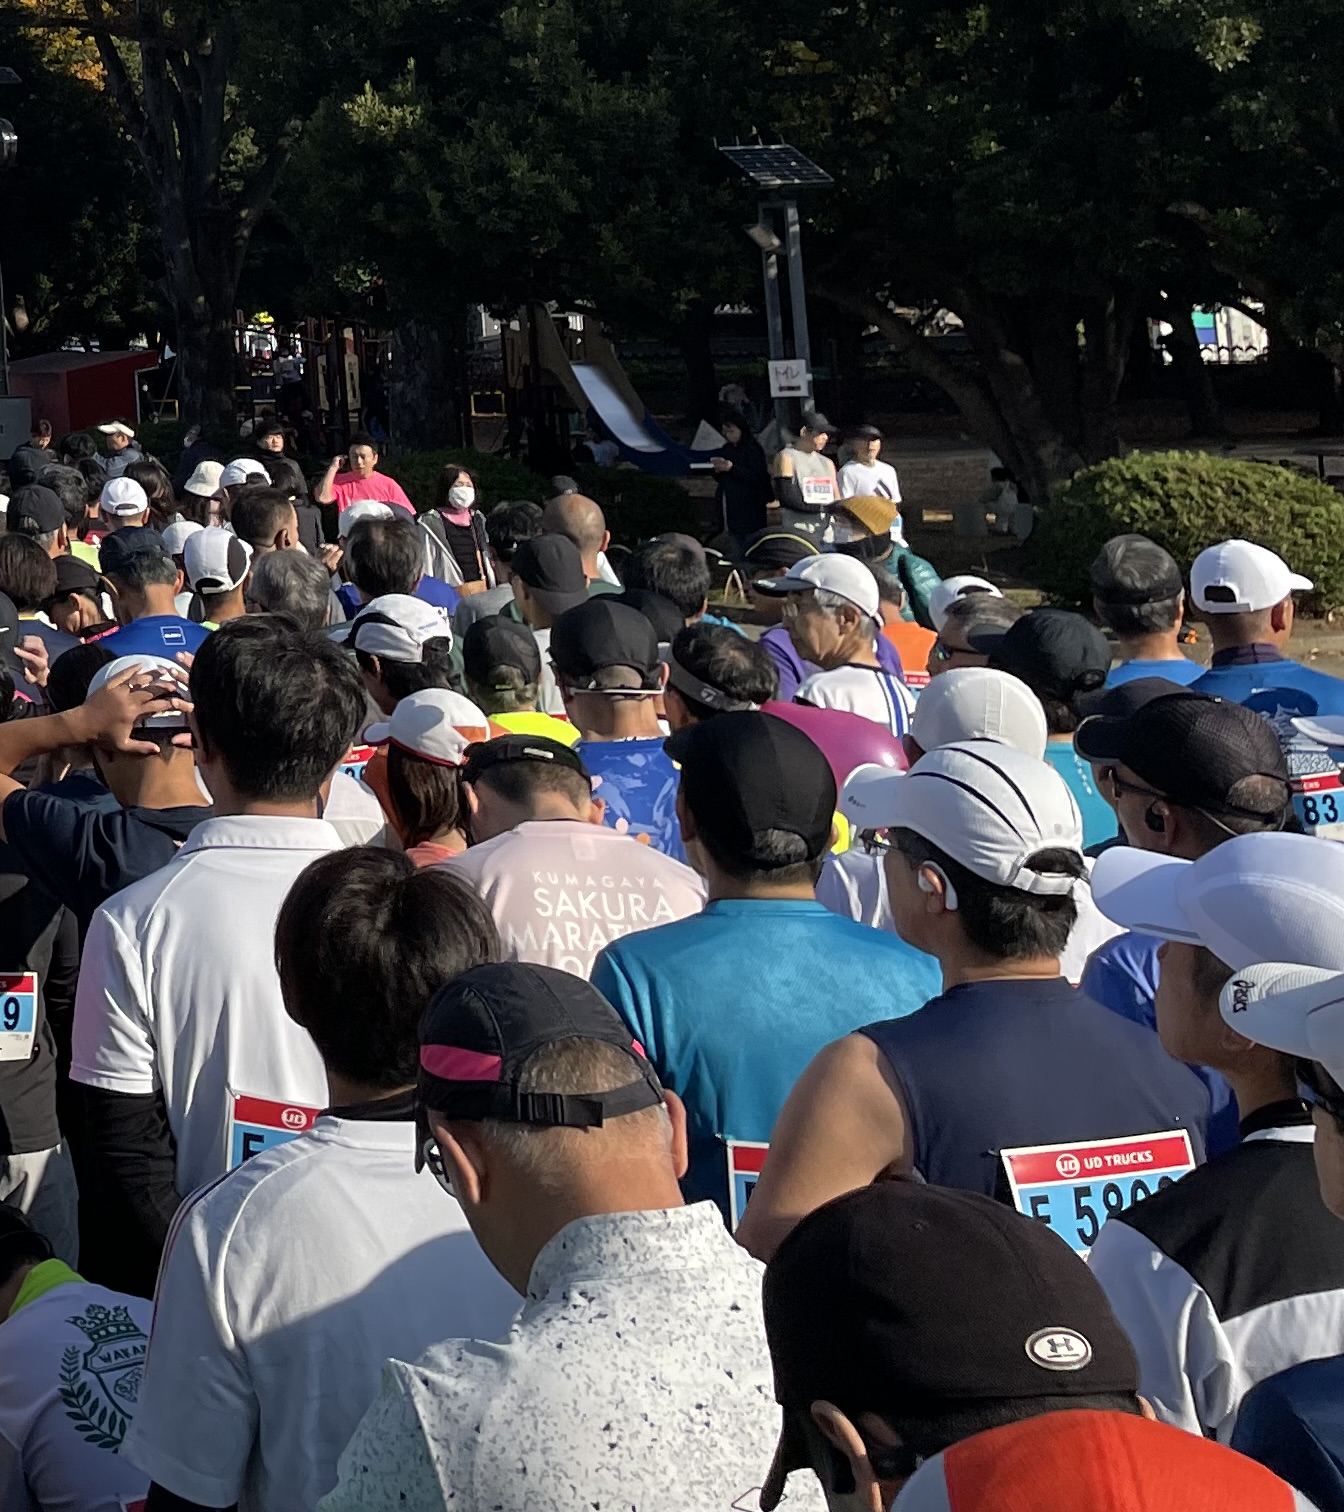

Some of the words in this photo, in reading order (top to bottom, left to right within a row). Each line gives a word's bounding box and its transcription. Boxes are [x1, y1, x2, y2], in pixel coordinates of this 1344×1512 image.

[531, 871, 664, 888] KUMAGAYA
[533, 888, 676, 922] SAKURA
[506, 920, 632, 953] MARAT
[1084, 1157, 1103, 1170] UD
[1104, 1149, 1154, 1168] TRUCKS
